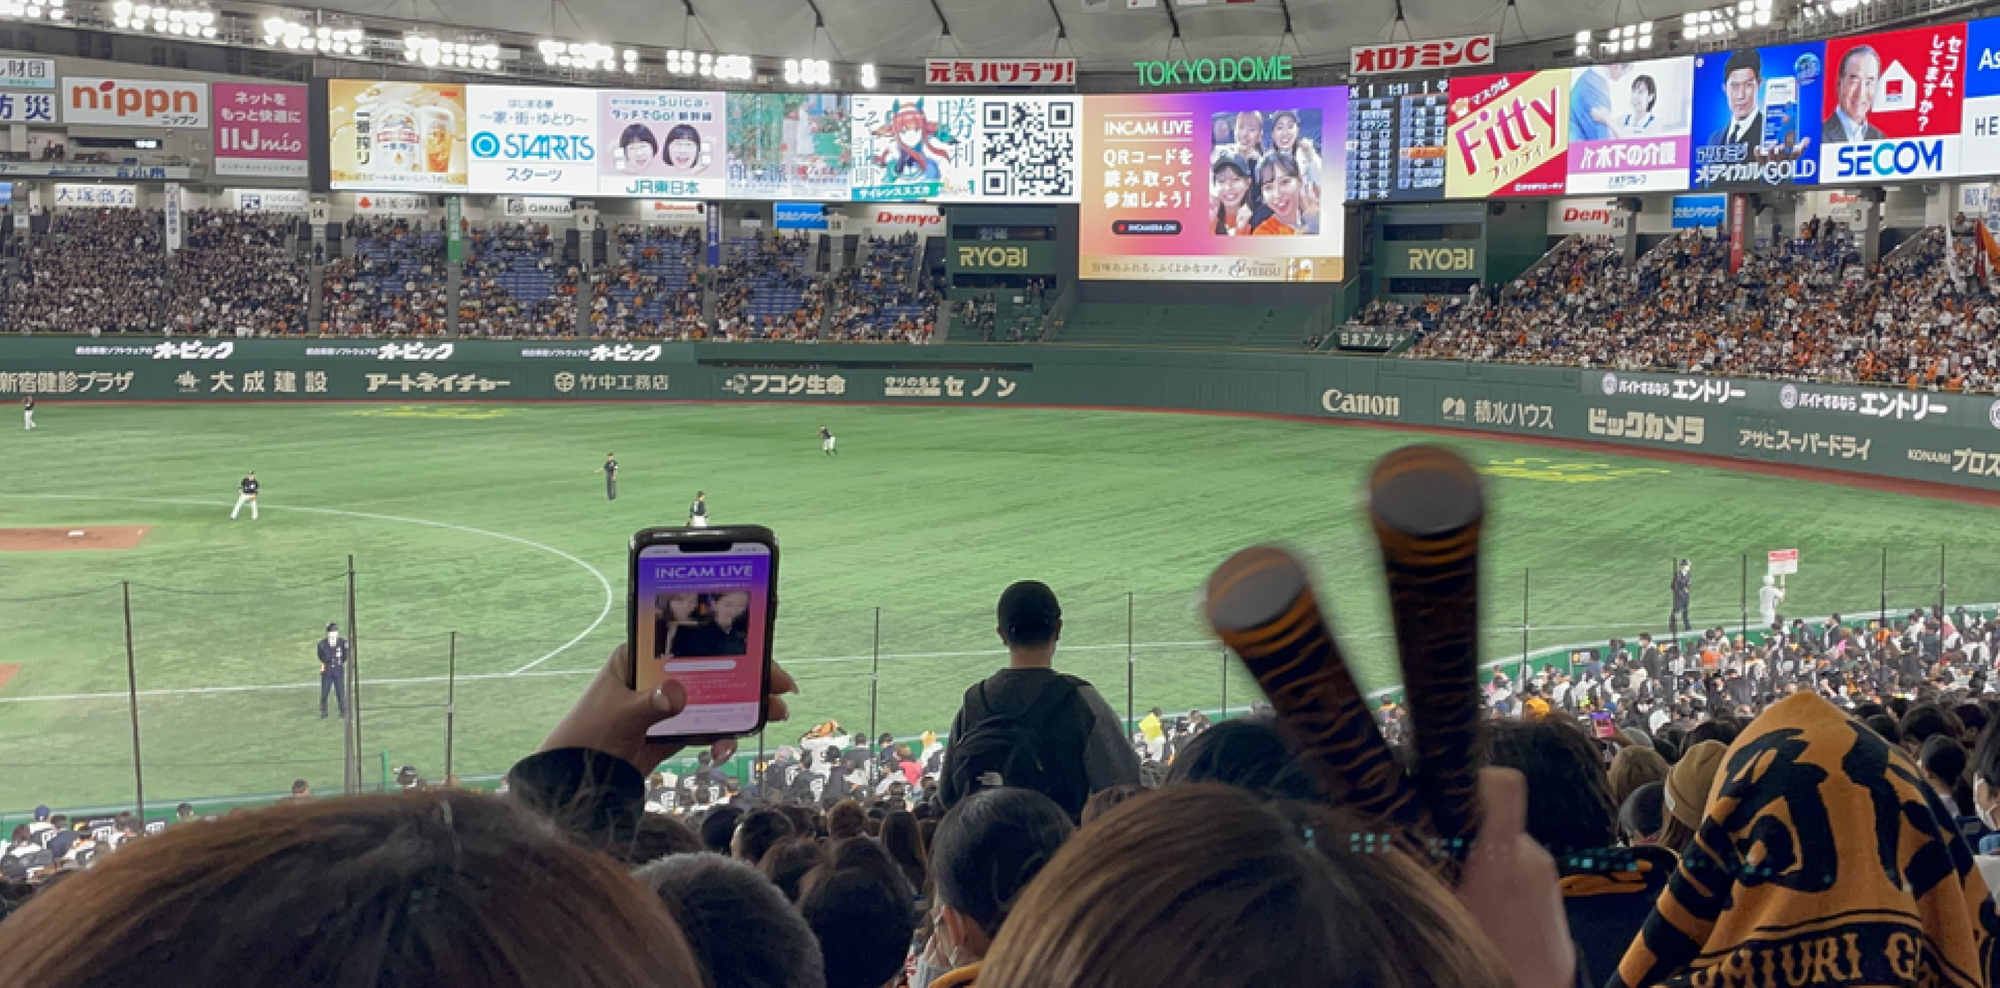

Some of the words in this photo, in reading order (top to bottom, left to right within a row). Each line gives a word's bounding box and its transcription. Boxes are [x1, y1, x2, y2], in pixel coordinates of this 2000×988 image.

[1355, 37, 1489, 72] オロナミンC
[0, 60, 45, 76] 財団
[929, 62, 1074, 82] 元気ハツラツ!
[1135, 59, 1216, 86] TOKYO
[1220, 56, 1292, 82] DOME
[72, 81, 198, 116] nippn
[235, 91, 287, 106] ネットを
[1104, 121, 1159, 135] INCAM
[1162, 120, 1193, 135] LIVE
[1455, 86, 1560, 176] Fitty
[1103, 148, 1193, 168] QRコードを
[1838, 140, 1943, 177] SECOM
[506, 168, 562, 183] スターツ
[1103, 170, 1193, 188] 読み取って
[626, 179, 700, 194] JR東日本
[1103, 191, 1191, 210] 参加しよう!
[877, 212, 941, 227] Denyo
[1563, 208, 1609, 225] Deny
[958, 247, 1028, 267] RYOBI
[1408, 248, 1474, 270] RYOBI
[152, 340, 234, 360] オービック
[377, 342, 454, 360] オービック
[589, 343, 662, 361] オービック
[210, 371, 328, 392] 大成建設
[365, 372, 511, 393] アートネイチャー
[580, 373, 669, 391] 竹中工務店
[750, 374, 846, 395] フコク生命
[944, 376, 1017, 397] セノン
[1671, 379, 1745, 404] エントリー
[1322, 388, 1400, 417] Canon
[1858, 391, 1947, 421] エントリー
[1474, 399, 1554, 430] 積水ハウス
[1588, 408, 1705, 445] ビックカメラ
[1739, 429, 1872, 461] アサヒスーパードライ
[655, 566, 715, 579] INCAM
[719, 564, 753, 577] LIVE
